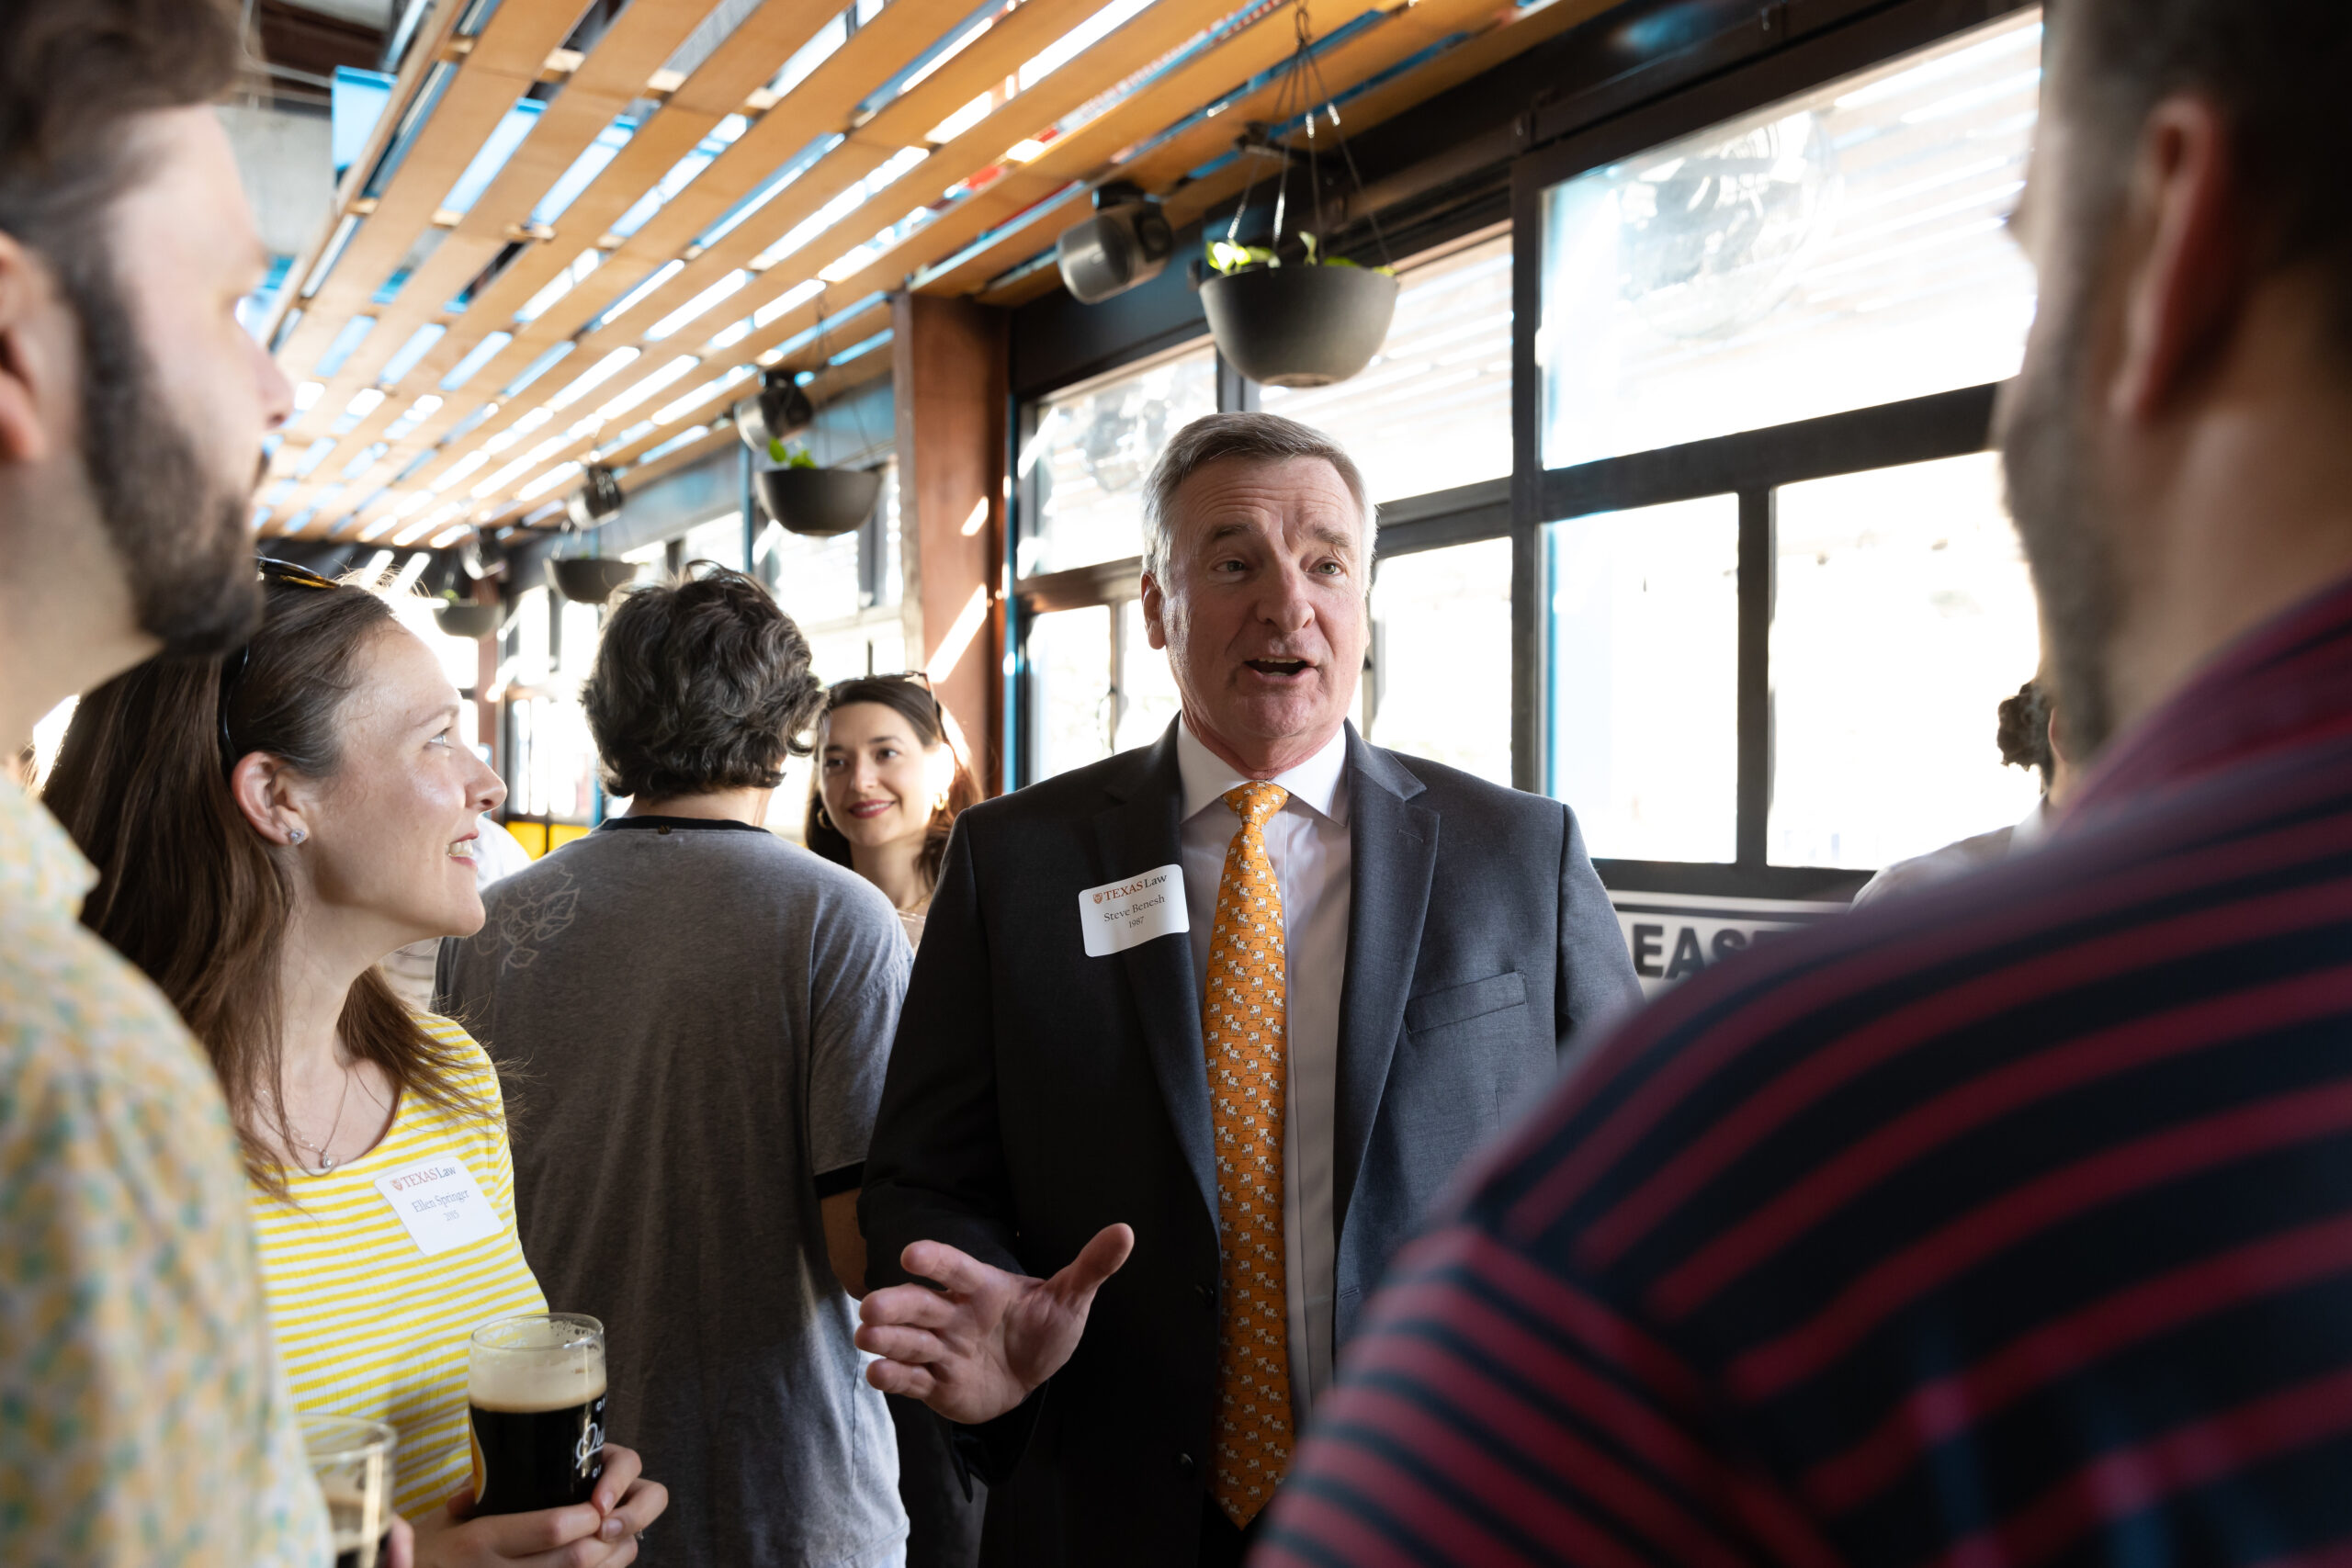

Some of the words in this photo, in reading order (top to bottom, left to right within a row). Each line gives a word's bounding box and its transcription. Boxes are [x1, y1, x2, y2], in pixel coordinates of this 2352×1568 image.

[1103, 881, 1143, 900] TEXAS
[1144, 874, 1167, 888] Law
[1103, 908, 1131, 922] Steve
[1132, 894, 1165, 914] Benesh
[1128, 916, 1144, 929] 1987
[1632, 923, 1792, 980] EAS
[401, 1168, 437, 1188] TEXAS
[435, 1167, 456, 1178] Law
[412, 1198, 435, 1213] Ellen
[435, 1190, 469, 1208] Springer
